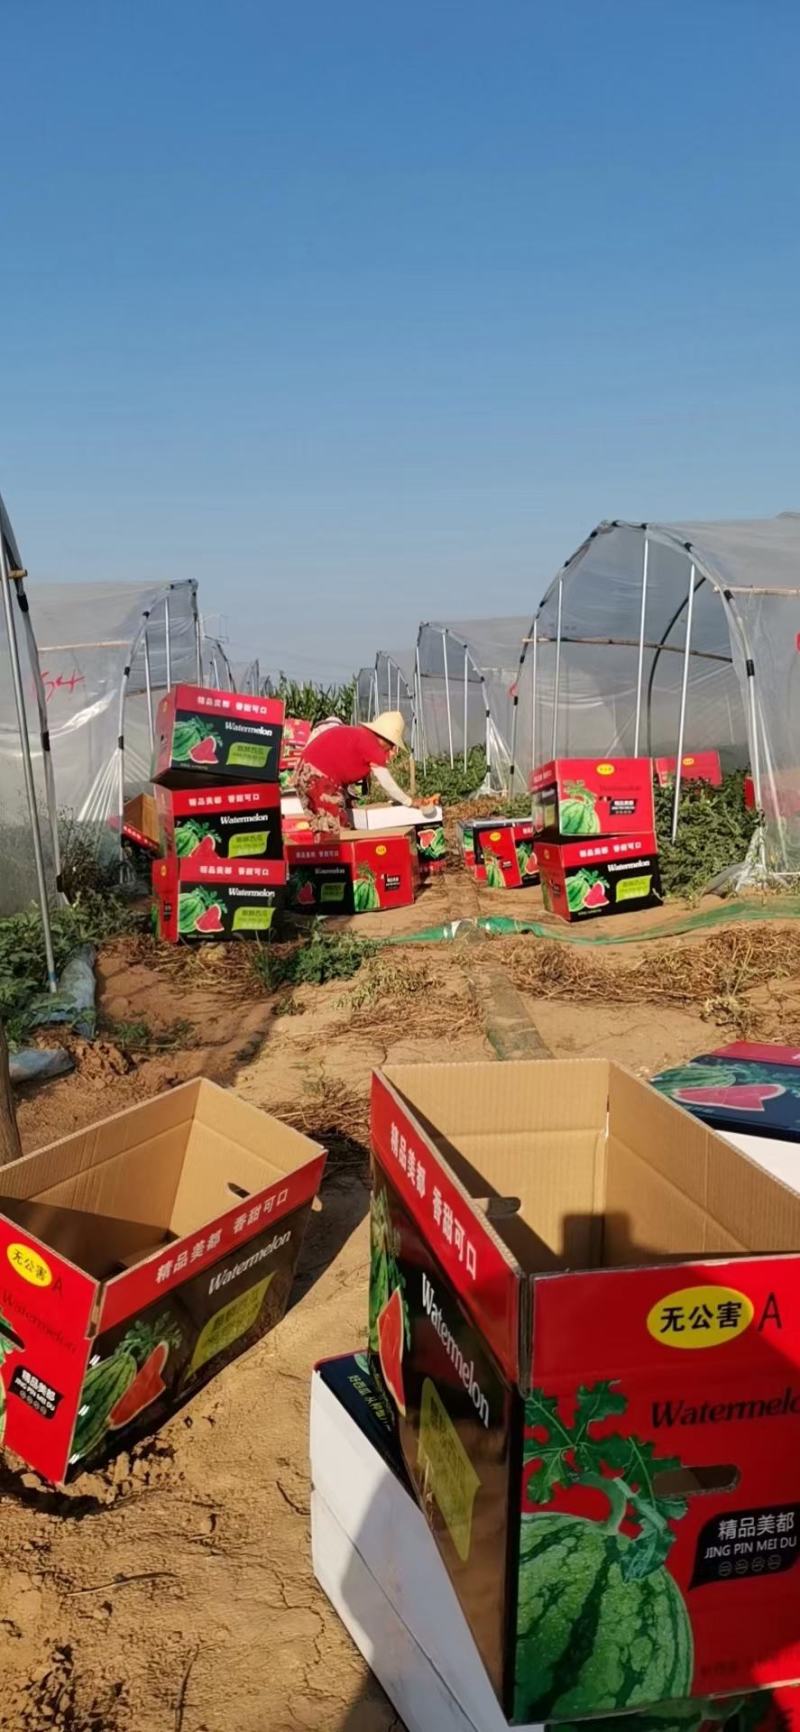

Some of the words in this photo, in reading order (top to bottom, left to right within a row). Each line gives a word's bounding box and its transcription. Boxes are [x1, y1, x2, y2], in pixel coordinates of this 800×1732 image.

[225, 721, 273, 737] Watermelon
[220, 813, 269, 825] Watermelon
[607, 859, 651, 873] Watermelon
[228, 887, 276, 898] Watermelon
[389, 1120, 427, 1200] 精品美都
[431, 1184, 478, 1281] 香甜可口
[154, 1227, 224, 1285] 精品美都
[232, 1188, 290, 1236] 香甜可口
[12, 1247, 49, 1282] 无公害
[208, 1229, 292, 1296] Watermelon
[52, 1276, 63, 1297] A
[659, 1301, 743, 1334] 无公害
[757, 1292, 782, 1332] A
[421, 1273, 490, 1430] Watermelon
[717, 1511, 795, 1541] 精品美都
[703, 1544, 731, 1559] JING
[733, 1541, 754, 1556] PIN
[755, 1538, 778, 1553] MEI
[779, 1535, 798, 1549] DU
